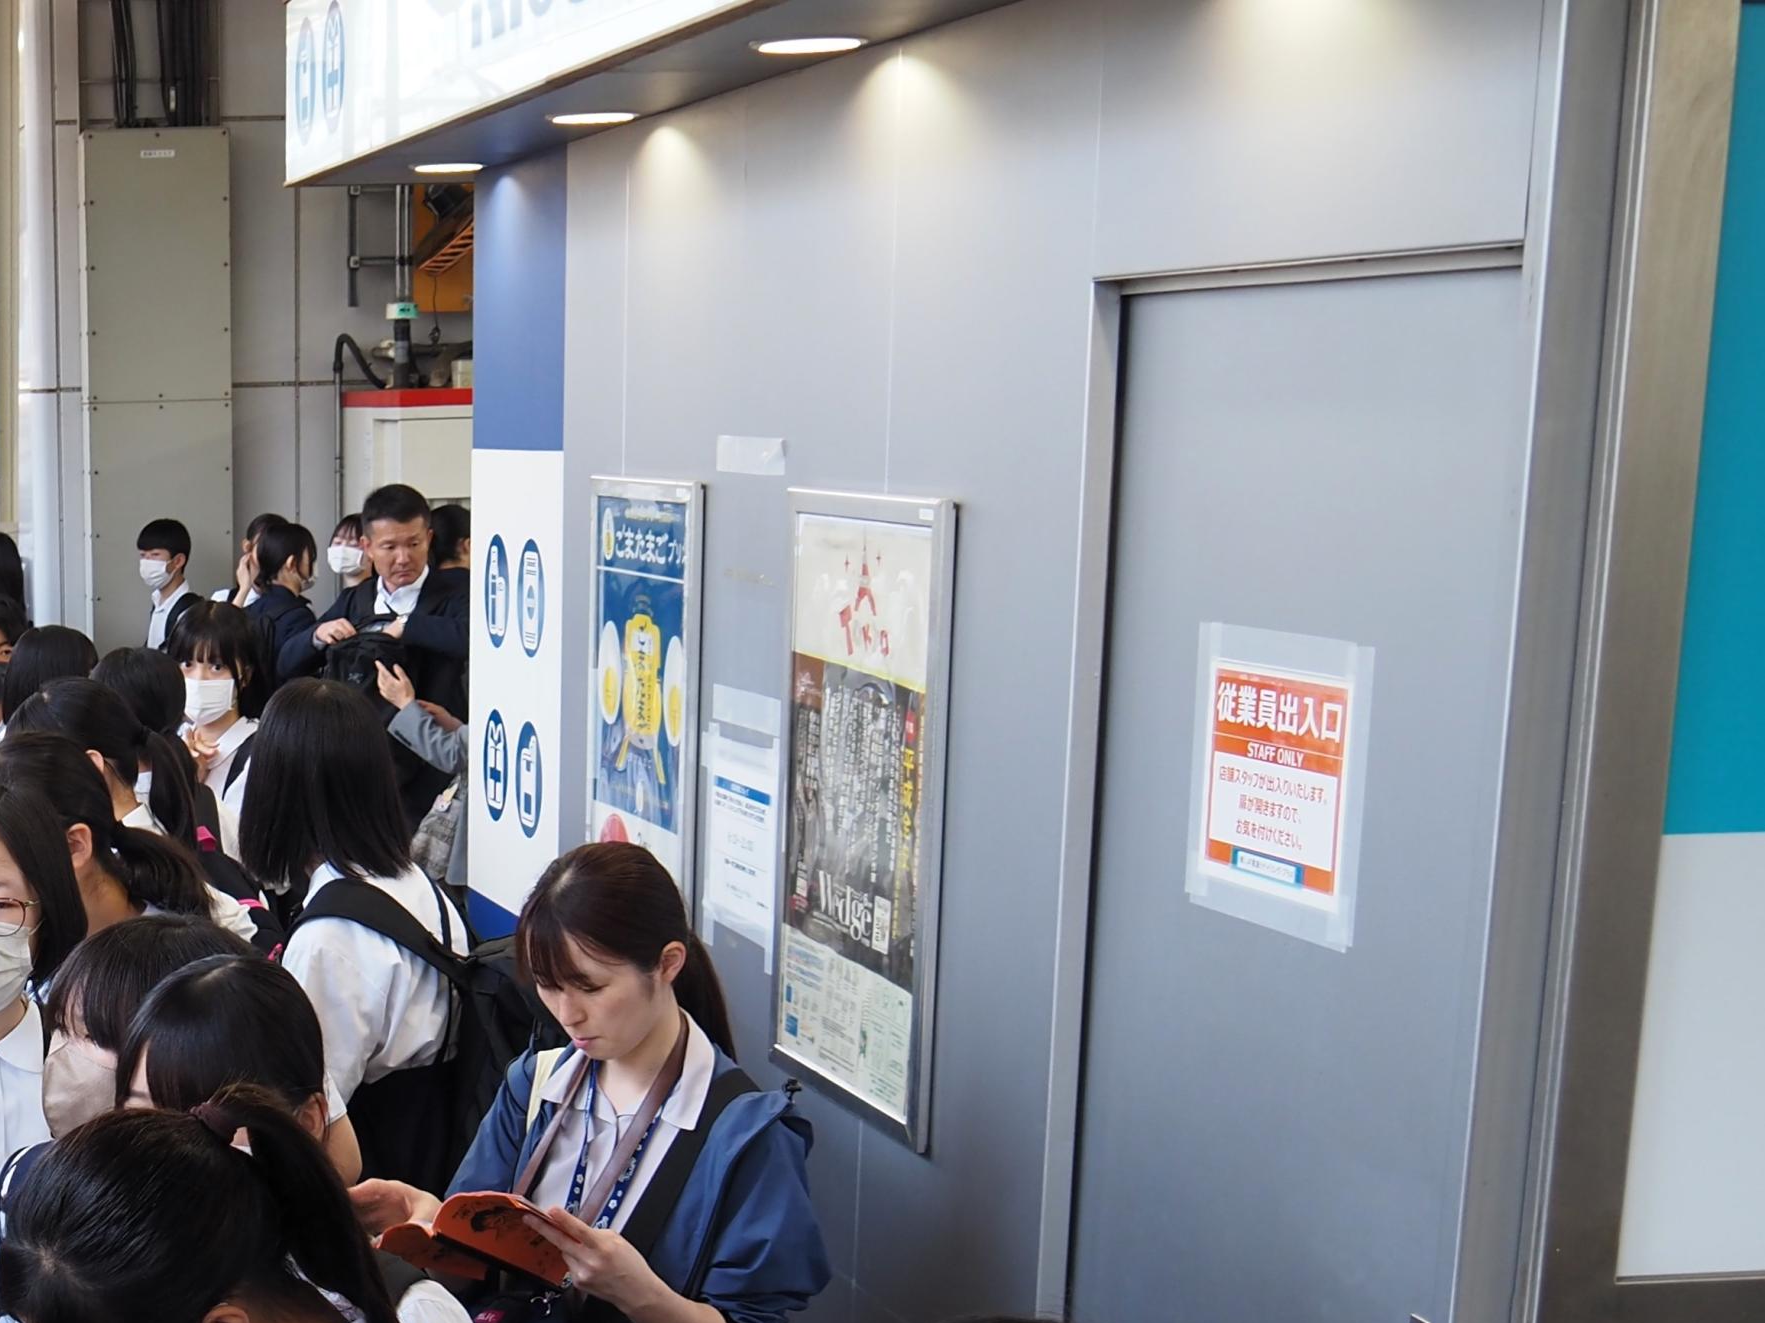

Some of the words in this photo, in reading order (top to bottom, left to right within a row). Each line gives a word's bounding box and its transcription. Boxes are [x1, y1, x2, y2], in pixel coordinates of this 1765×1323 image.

[1216, 681, 1343, 743] 従業員出入口
[1246, 741, 1275, 762] STAFF
[1277, 748, 1305, 768] ONLY
